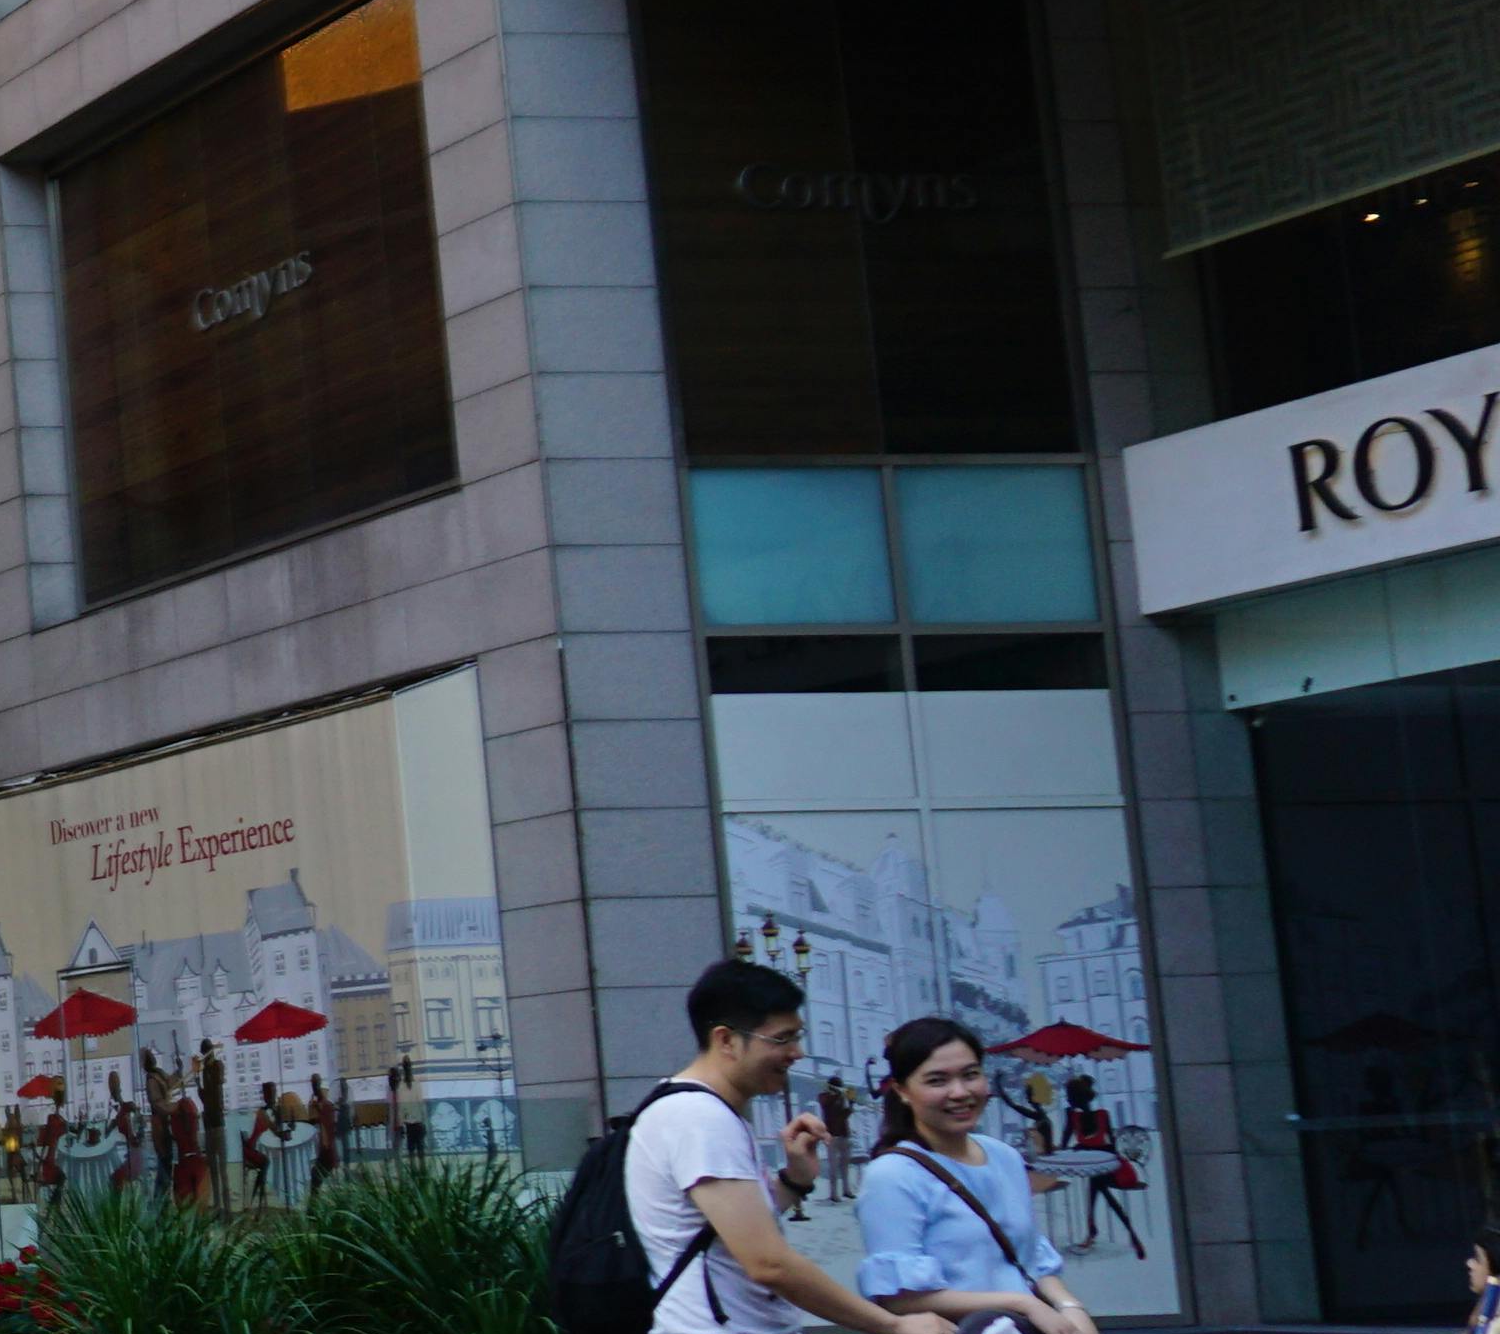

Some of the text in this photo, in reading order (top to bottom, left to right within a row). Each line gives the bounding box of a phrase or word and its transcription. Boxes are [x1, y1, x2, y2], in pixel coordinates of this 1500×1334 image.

[734, 161, 980, 223] Comyns
[192, 251, 313, 331] Comyns
[1287, 391, 1500, 532] ROY
[50, 807, 160, 845] Discover a new
[91, 817, 296, 892] Lifestyle Experience
